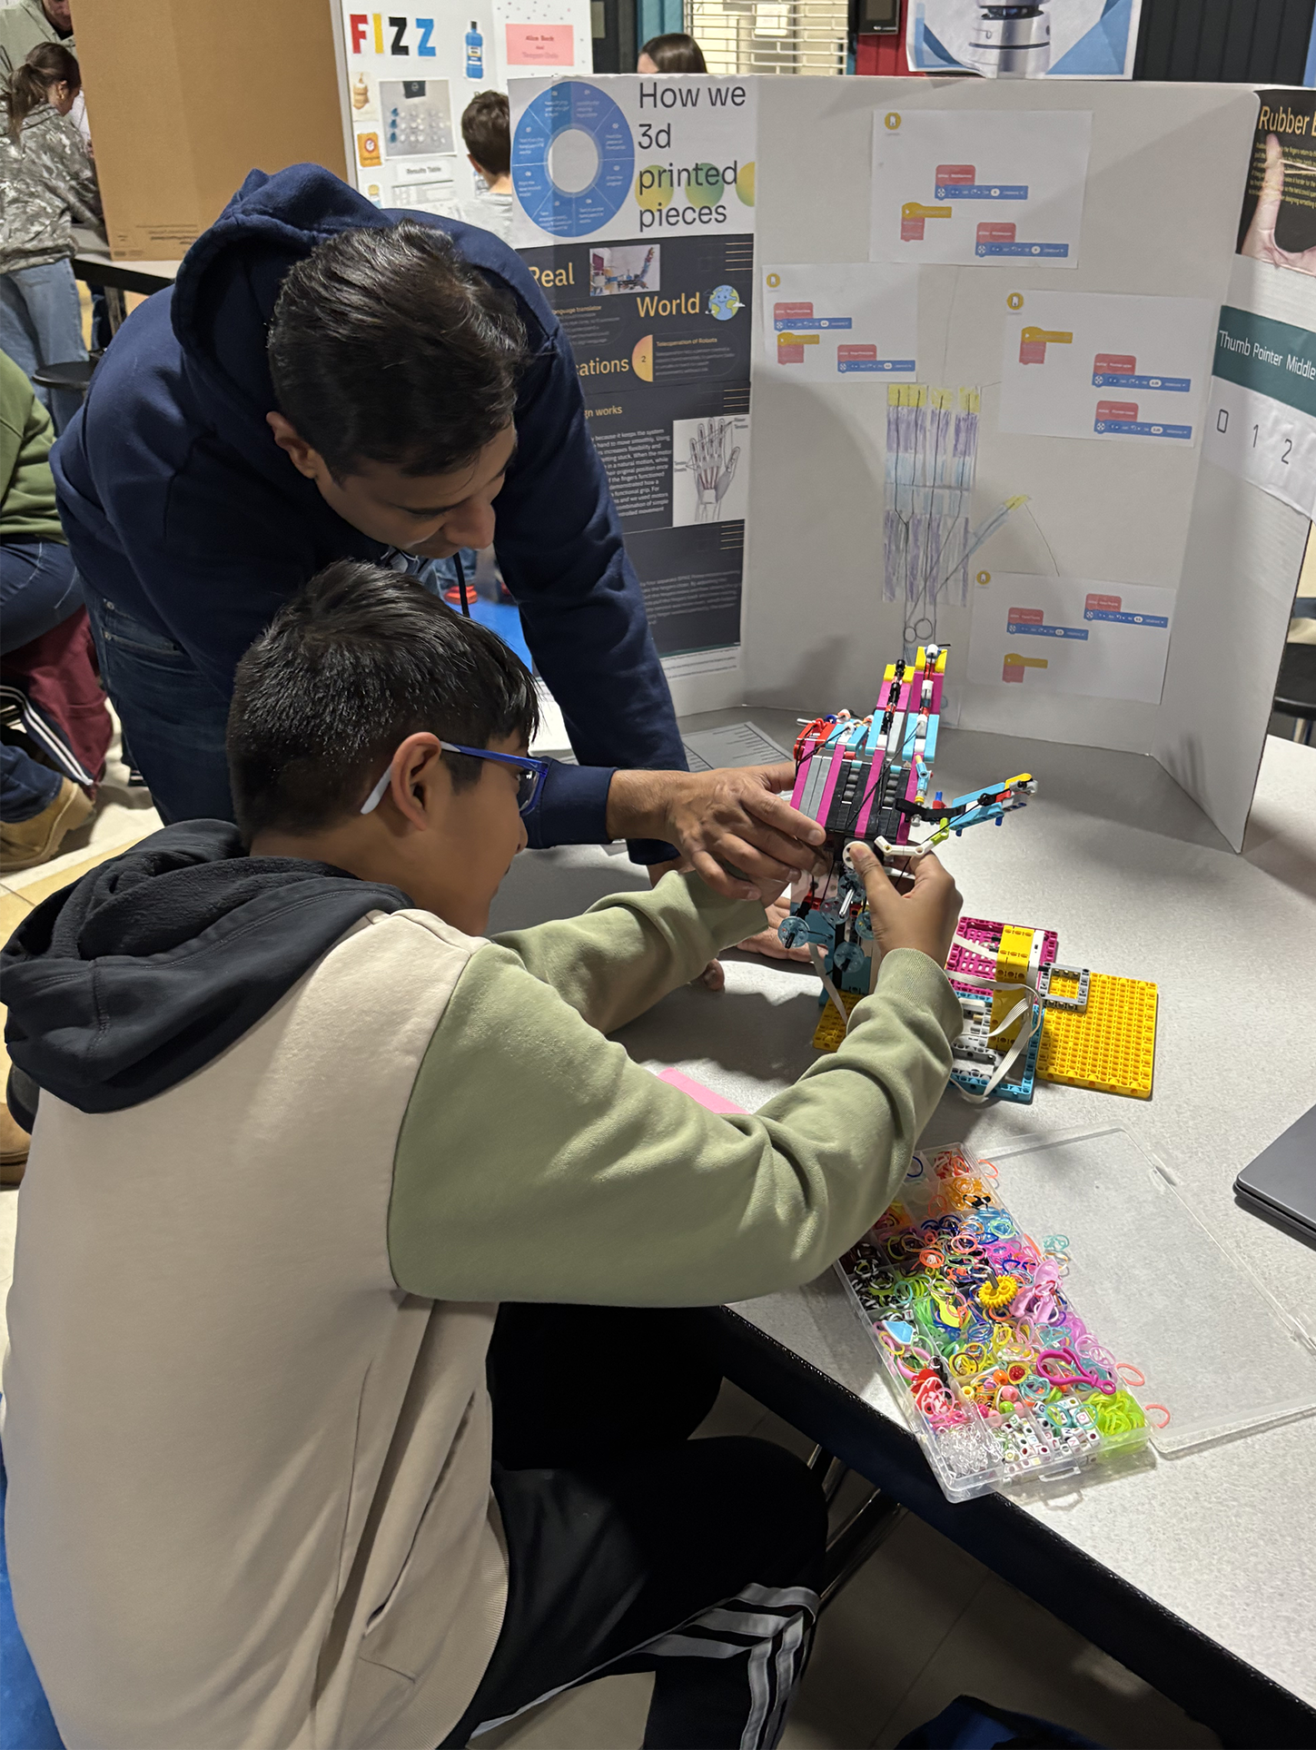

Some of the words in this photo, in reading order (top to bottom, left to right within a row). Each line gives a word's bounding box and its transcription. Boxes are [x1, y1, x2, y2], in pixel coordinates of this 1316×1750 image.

[350, 13, 436, 57] FIZZ
[640, 82, 700, 108] How
[708, 86, 746, 106] we
[1258, 105, 1310, 136] Rubber
[638, 123, 671, 149] 3d
[640, 160, 738, 196] printed
[640, 202, 727, 233] pieces
[528, 262, 575, 288] Real
[637, 292, 700, 318] World
[641, 355, 646, 363] 2
[1219, 330, 1251, 357] Thumb
[1252, 342, 1283, 367] Pointer
[1286, 353, 1316, 381] Middle
[595, 405, 623, 417] works
[1252, 424, 1259, 448] 1
[1281, 438, 1293, 465] 2
